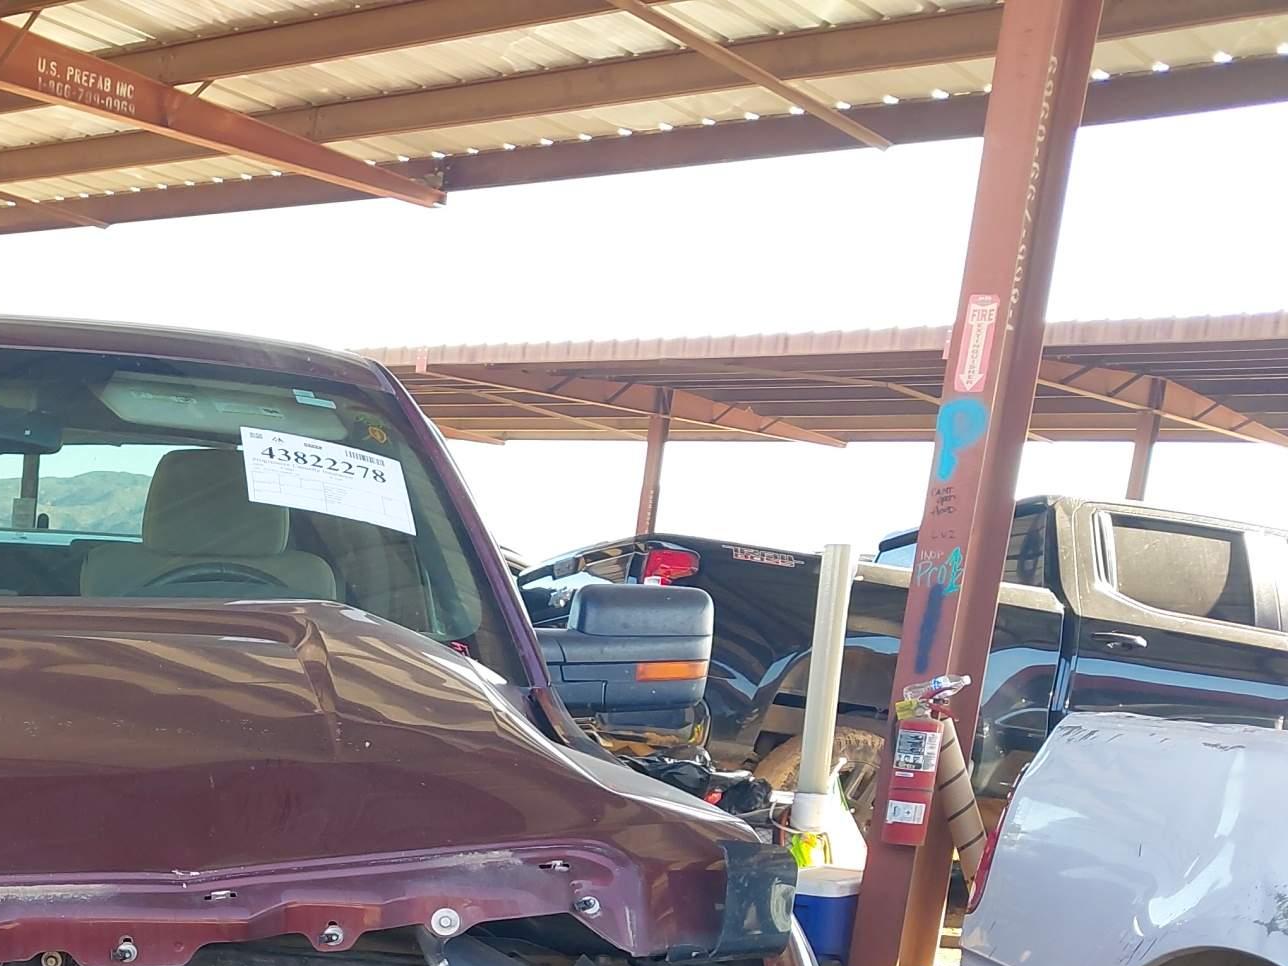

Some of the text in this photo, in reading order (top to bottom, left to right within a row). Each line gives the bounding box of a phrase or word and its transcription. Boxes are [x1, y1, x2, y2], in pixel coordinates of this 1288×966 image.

[37, 57, 60, 79] U.S.
[66, 66, 111, 92] PREFAB
[971, 308, 995, 321] FIRE
[260, 445, 388, 485] 43822278
